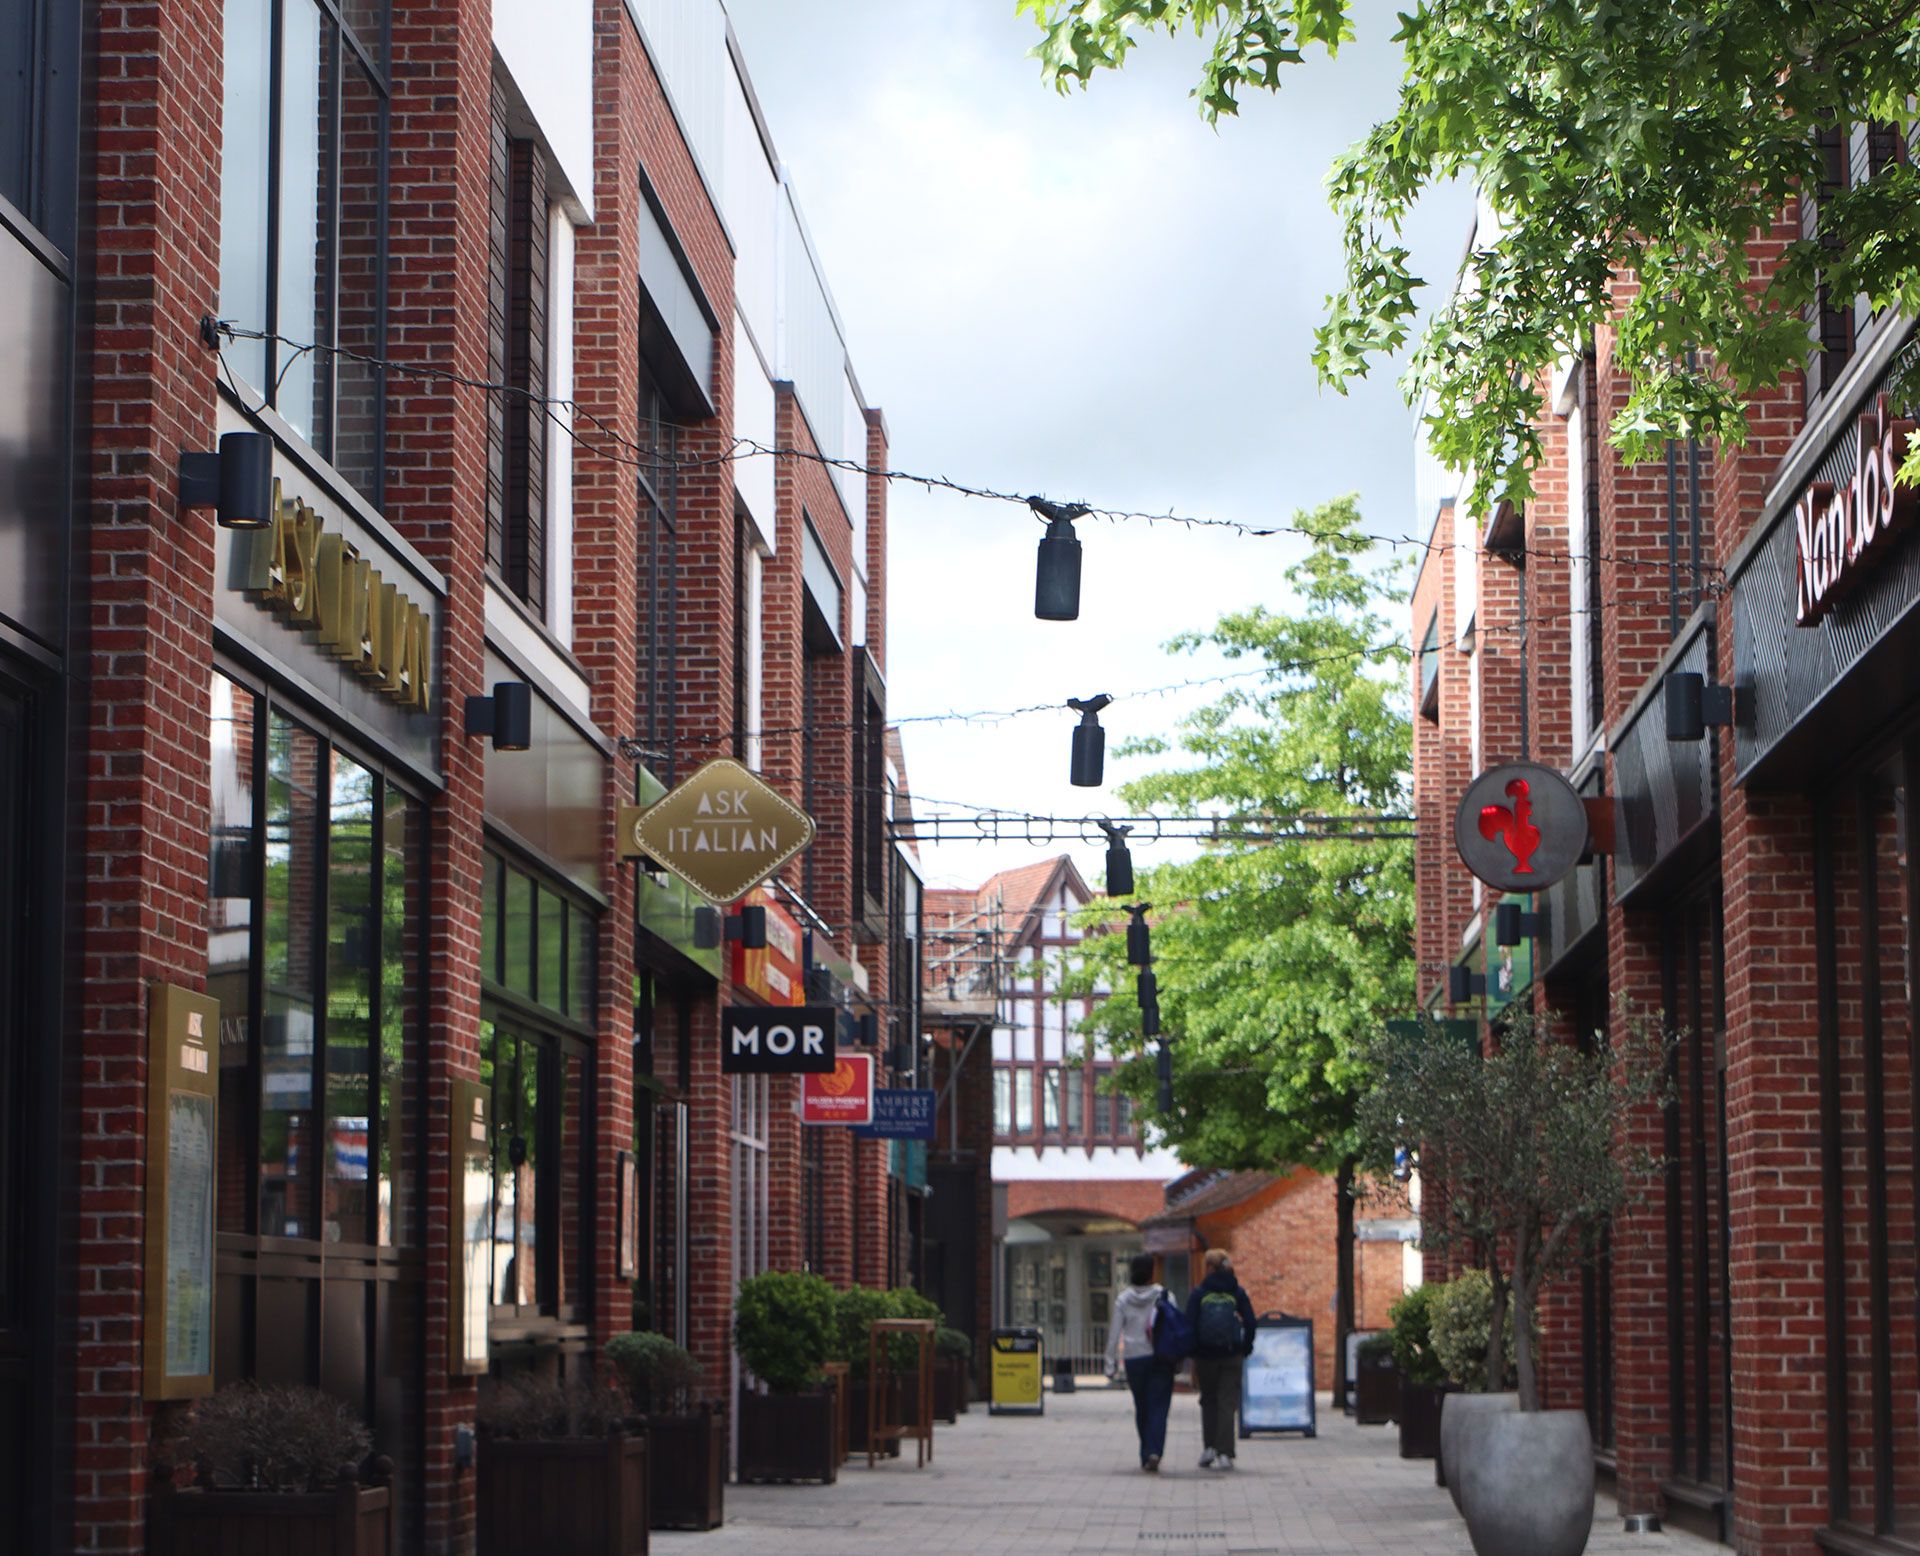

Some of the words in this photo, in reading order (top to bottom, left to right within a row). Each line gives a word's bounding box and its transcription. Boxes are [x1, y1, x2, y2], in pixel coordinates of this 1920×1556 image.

[1795, 393, 1894, 622] Nando's
[696, 790, 749, 815] ASK
[667, 827, 777, 852] ITALIAN
[731, 1025, 824, 1055] MOR
[874, 1095, 930, 1106] AMBERT
[903, 1106, 929, 1118] ART
